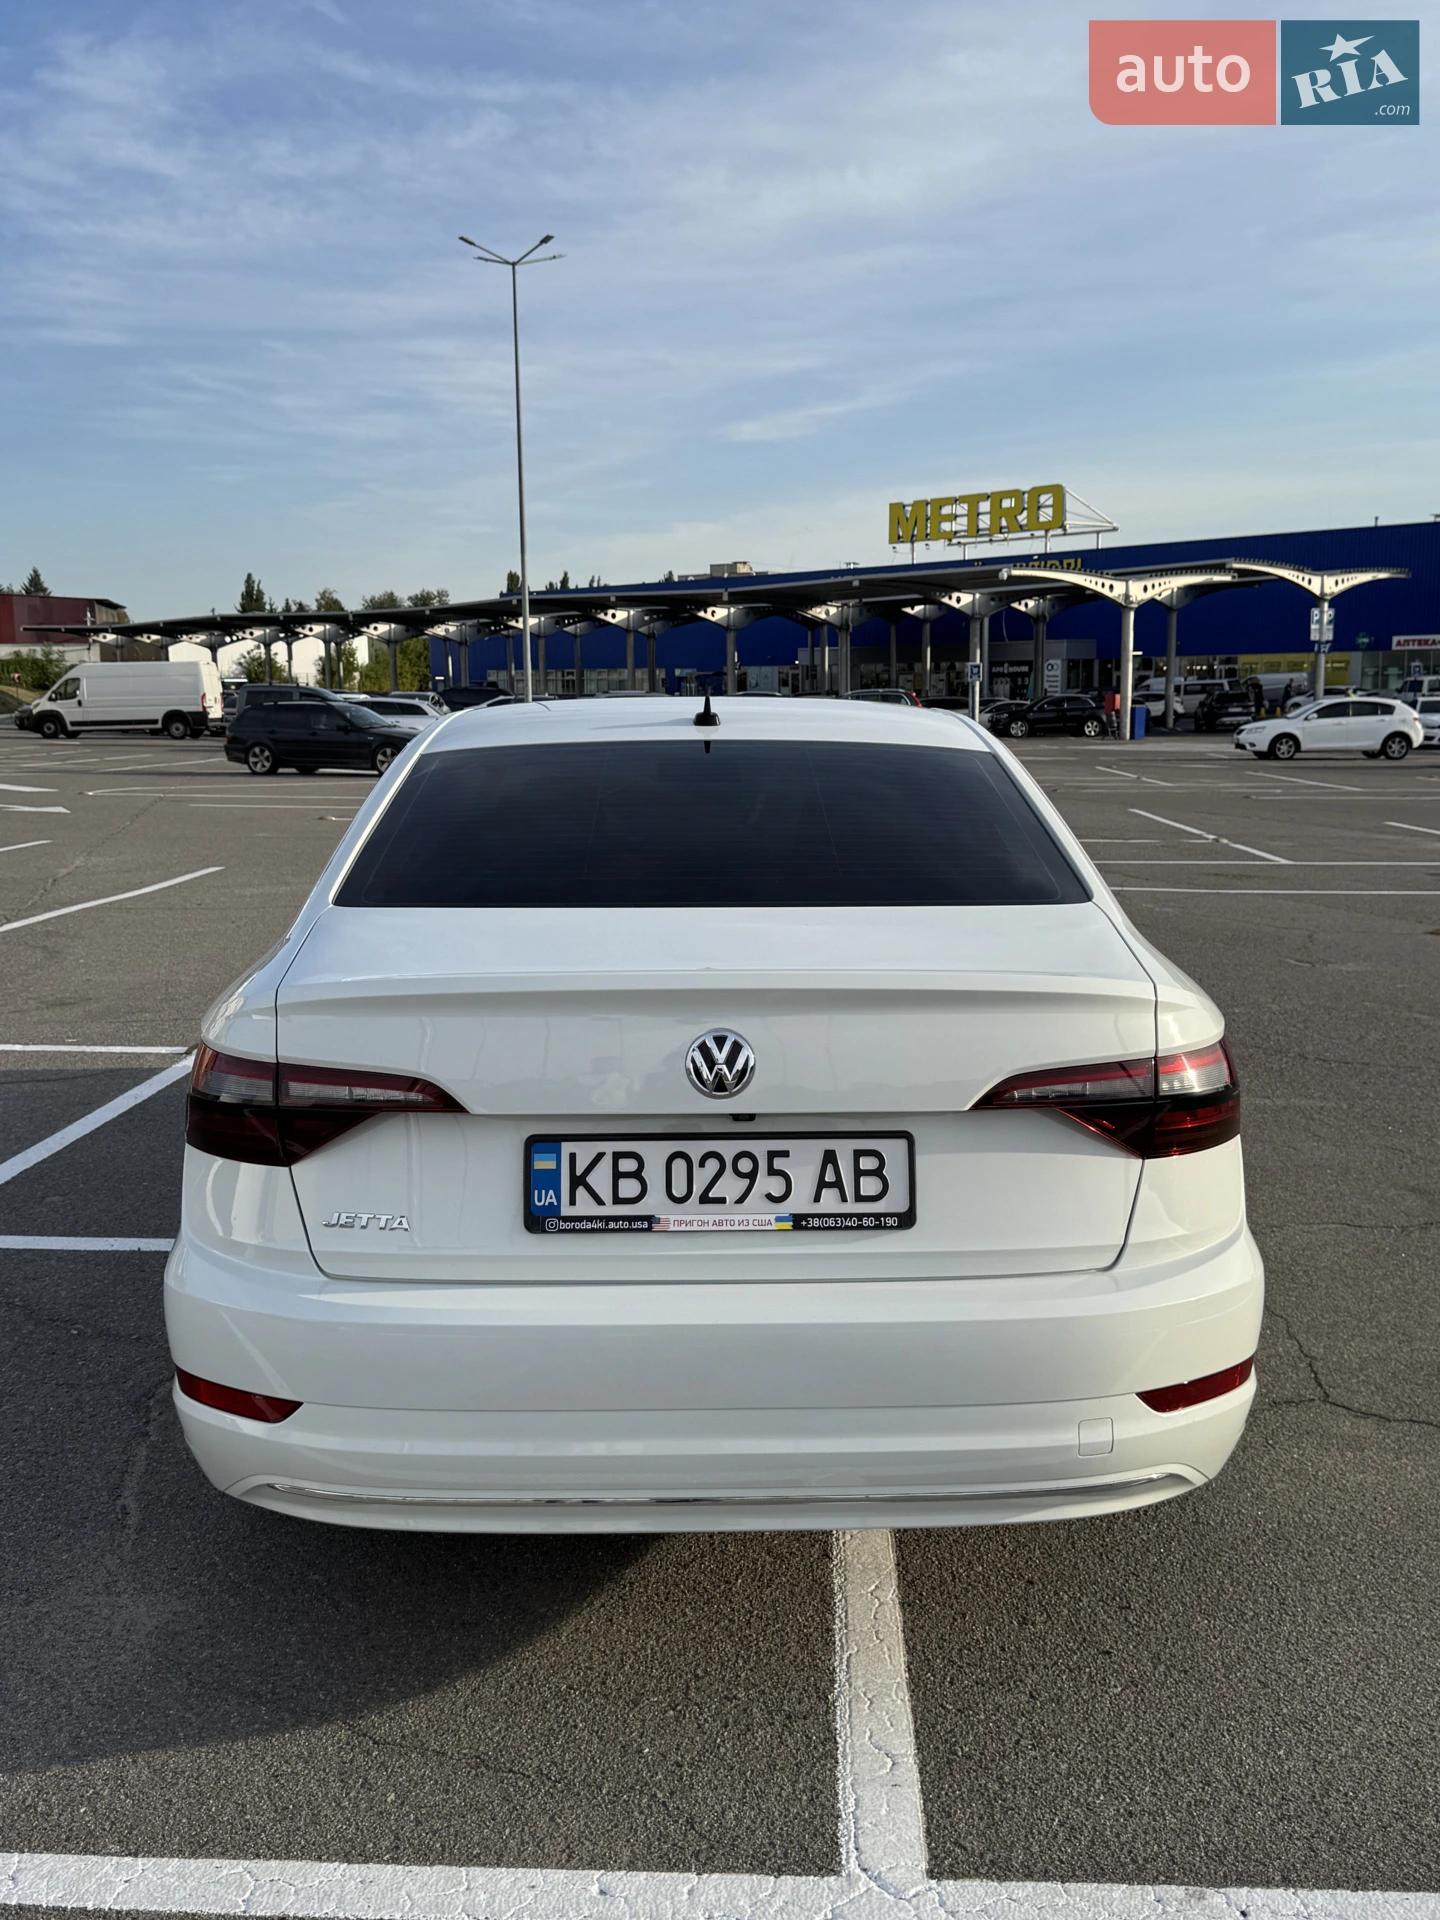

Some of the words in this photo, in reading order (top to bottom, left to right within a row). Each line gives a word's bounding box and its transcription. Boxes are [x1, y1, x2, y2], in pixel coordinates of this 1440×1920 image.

[888, 483, 1066, 544] METRO
[1395, 638, 1437, 648] АПТЕКА
[568, 1151, 648, 1206] KB
[664, 1149, 793, 1205] 0295
[813, 1148, 890, 1203] AB
[533, 1189, 558, 1206] UA
[321, 1211, 411, 1232] JETTA
[559, 1219, 649, 1230] boroda4ki.auto.usa
[673, 1219, 709, 1228] ПРИГОН
[712, 1219, 736, 1227] АВТО
[738, 1218, 750, 1227] ИЗ
[752, 1218, 773, 1227] США
[801, 1217, 898, 1229] +38(063)40-60-190
